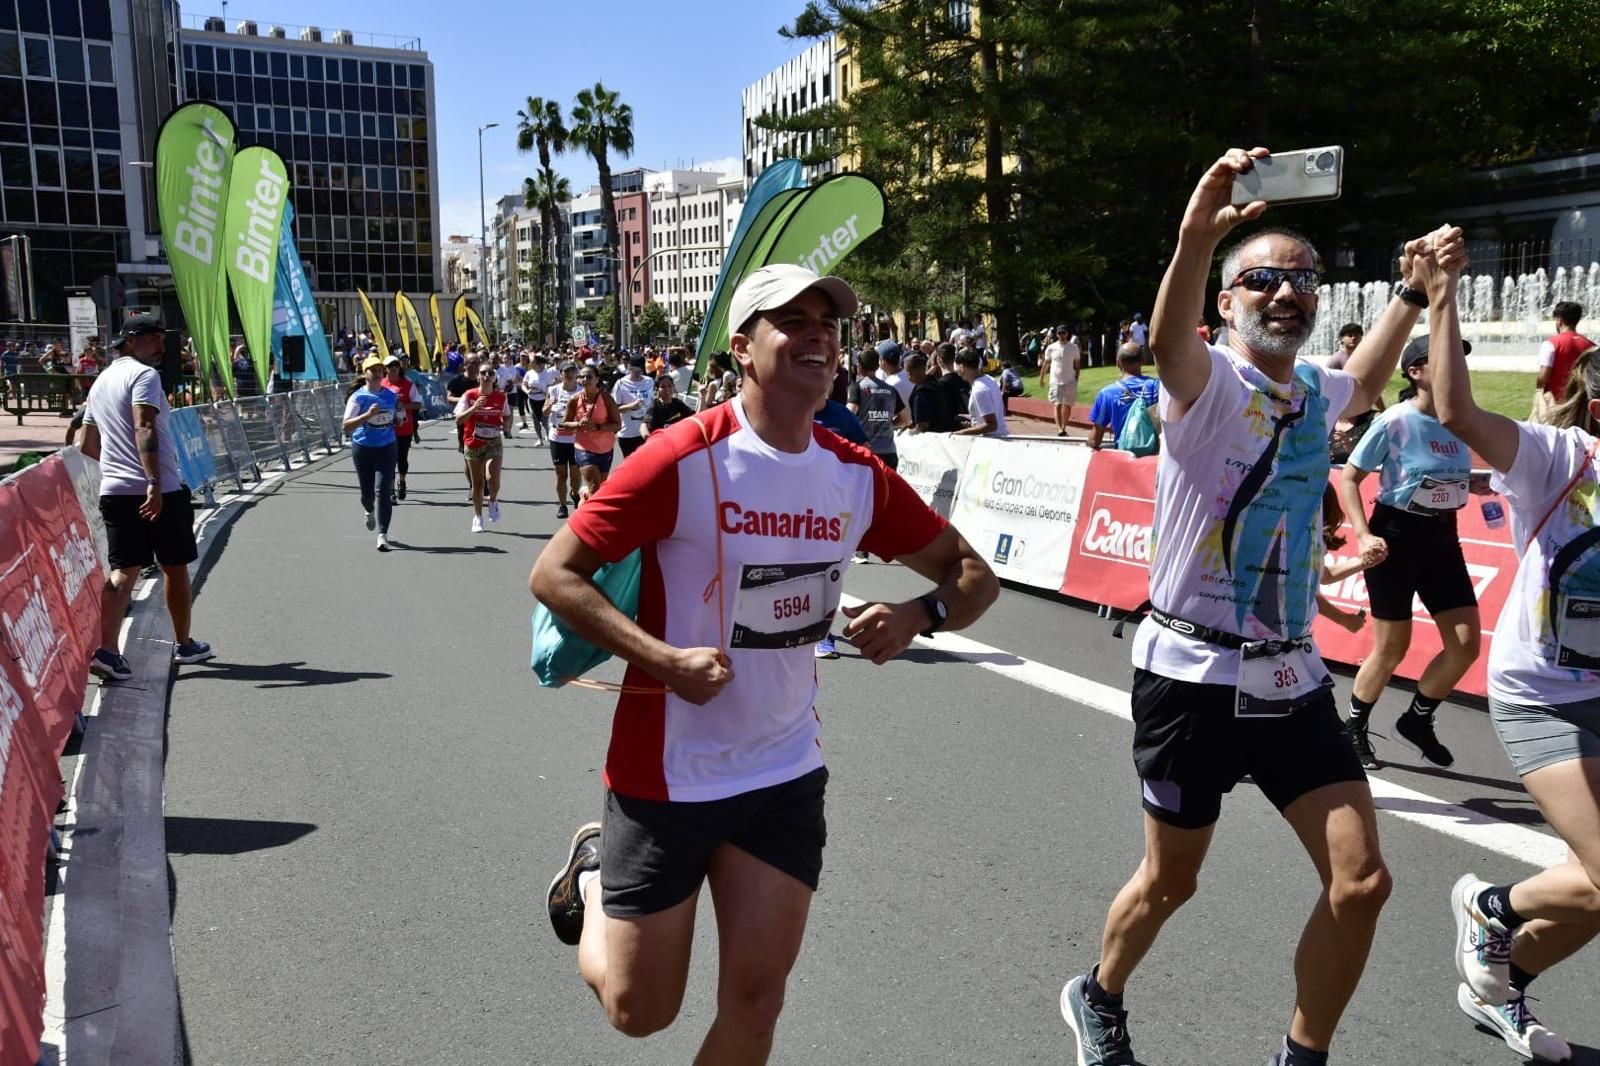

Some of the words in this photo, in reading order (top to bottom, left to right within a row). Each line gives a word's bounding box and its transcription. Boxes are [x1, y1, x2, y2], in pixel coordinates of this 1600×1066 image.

[174, 117, 228, 265] Binter
[235, 159, 284, 284] Binter
[798, 213, 858, 278] inter
[867, 410, 889, 419] TEAM
[1431, 492, 1449, 503] 2207
[1038, 505, 1072, 523] Deporte
[773, 593, 811, 620] 5594
